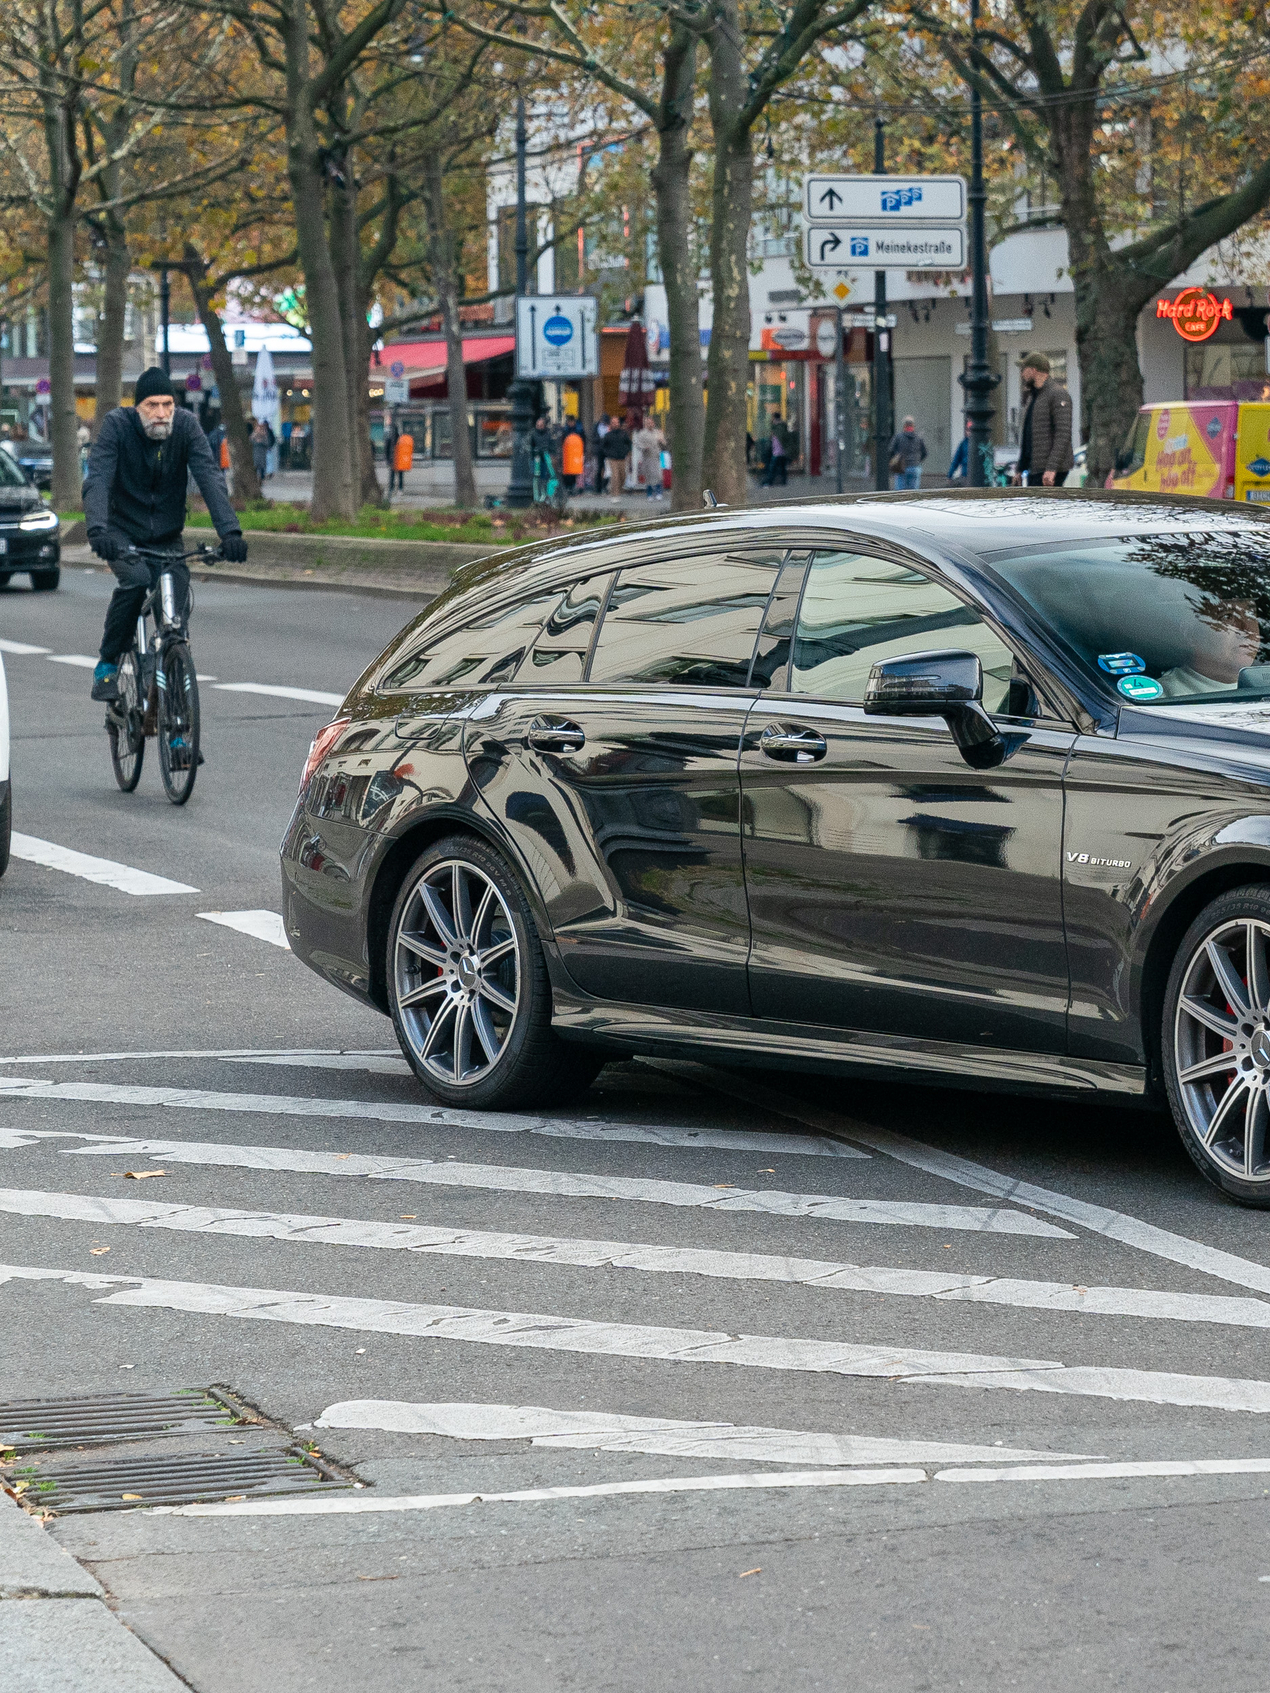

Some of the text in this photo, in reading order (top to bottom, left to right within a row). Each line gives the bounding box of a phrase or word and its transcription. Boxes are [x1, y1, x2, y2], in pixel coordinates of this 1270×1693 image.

[875, 240, 952, 255] Meinekestraße
[1156, 298, 1234, 321] Hard Rock
[1184, 321, 1207, 332] CAFE
[1066, 851, 1132, 869] V8 BITURBO
